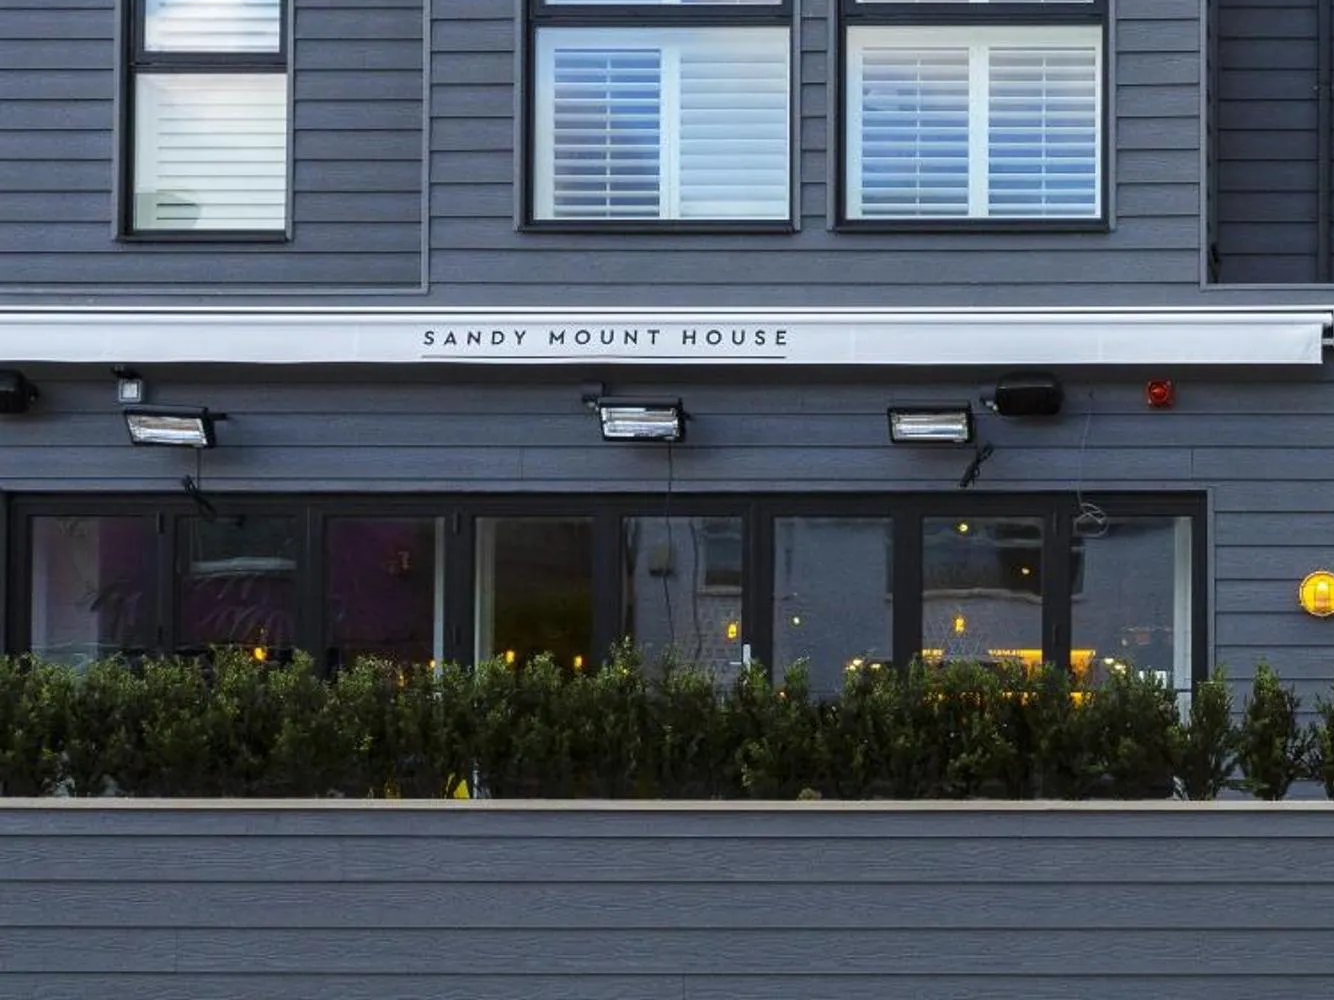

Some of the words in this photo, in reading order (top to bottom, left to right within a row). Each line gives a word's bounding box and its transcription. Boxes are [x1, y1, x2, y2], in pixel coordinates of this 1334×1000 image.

[423, 329, 527, 346] SANDY
[548, 329, 661, 346] MOUNT
[681, 329, 788, 346] HOUSE
